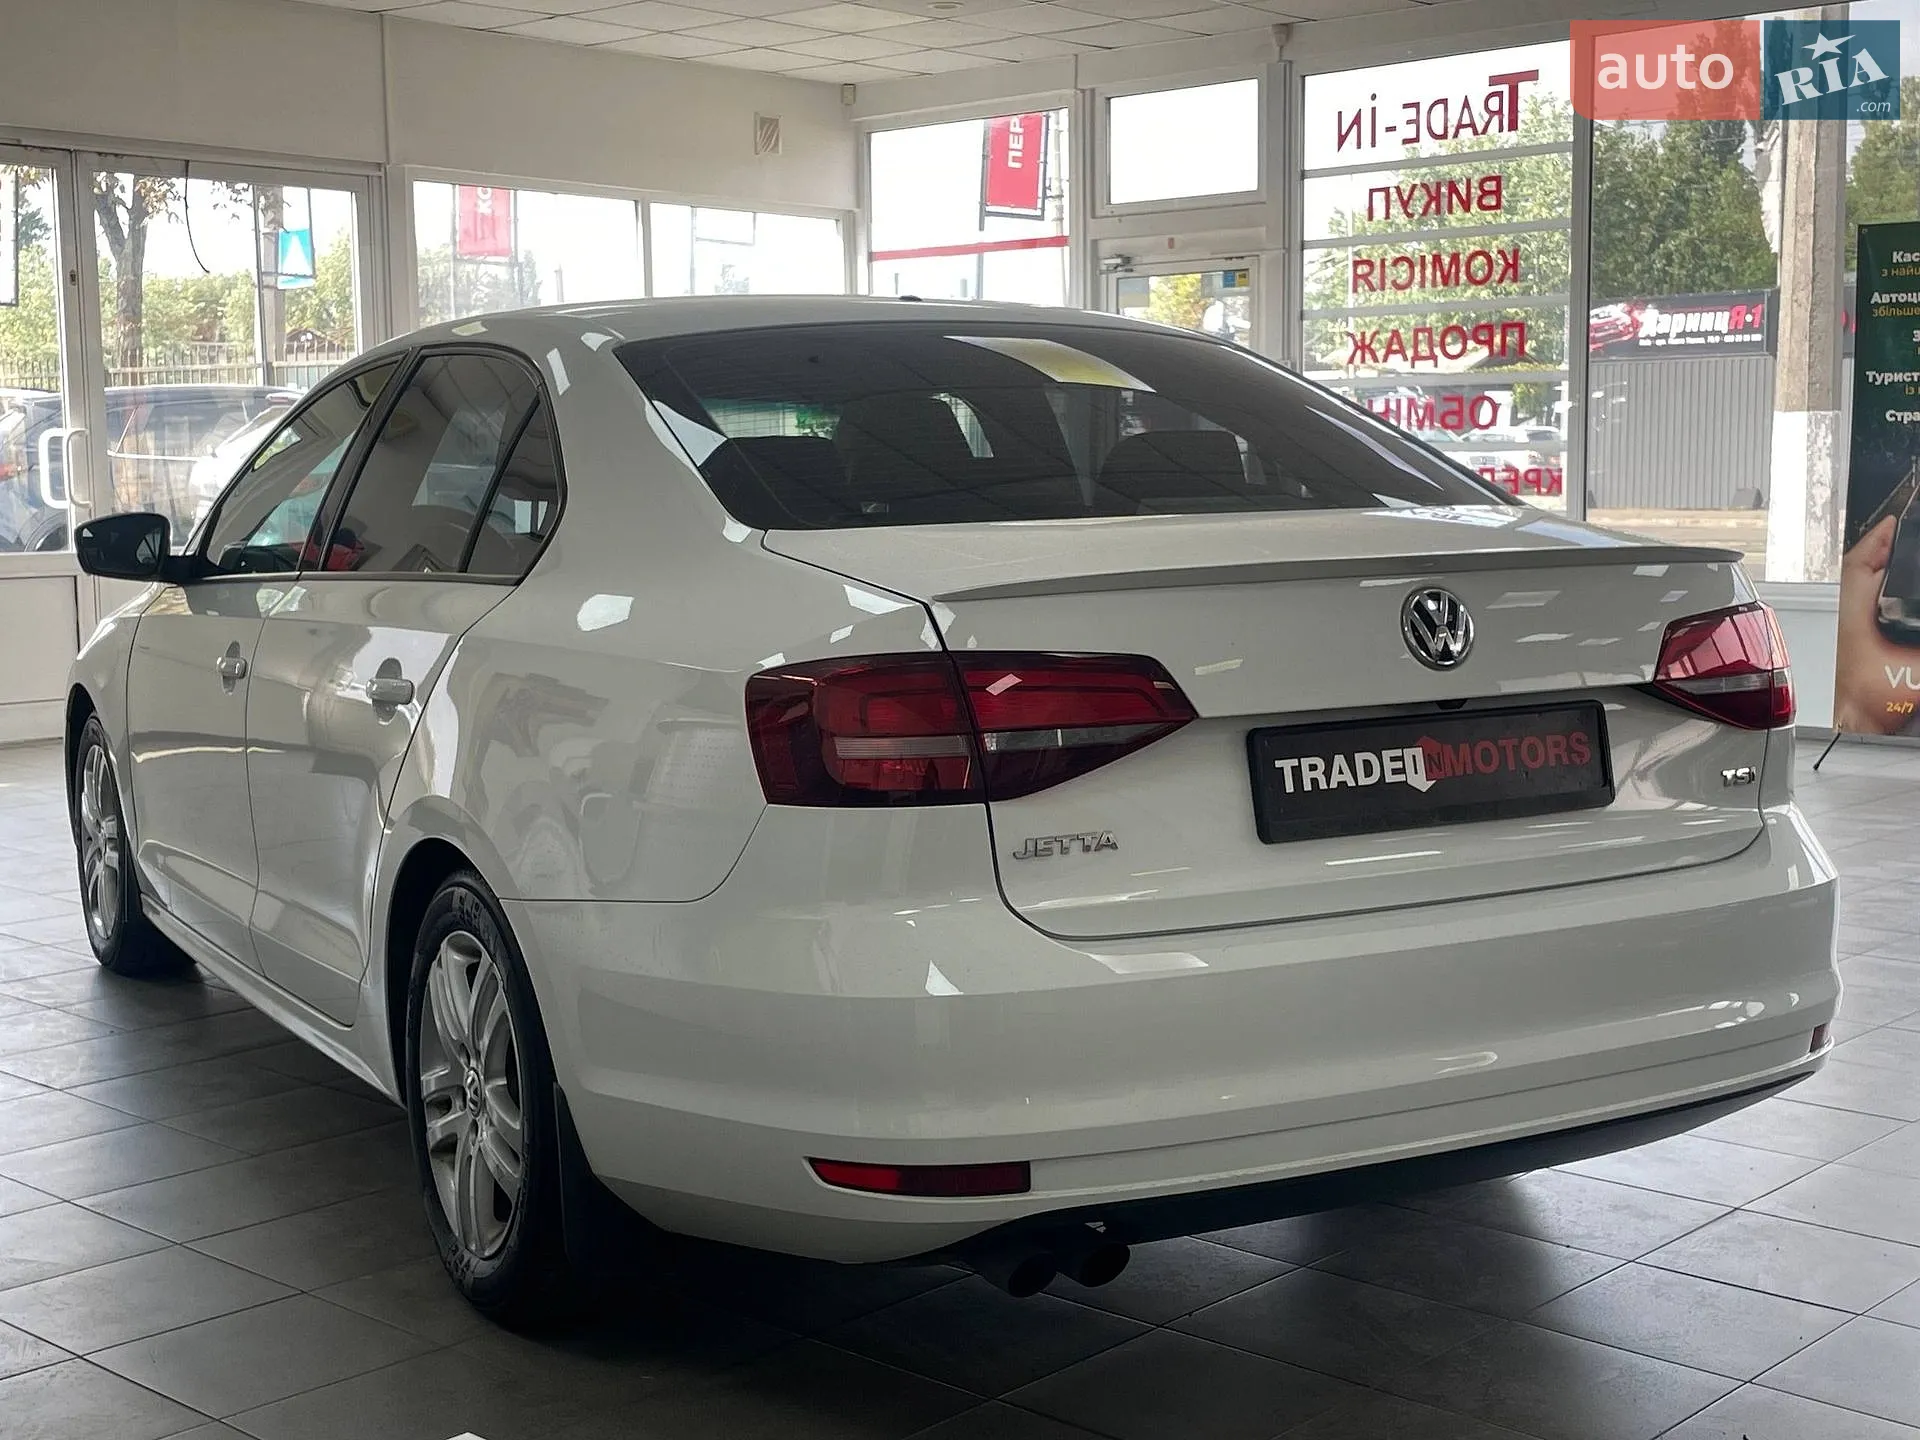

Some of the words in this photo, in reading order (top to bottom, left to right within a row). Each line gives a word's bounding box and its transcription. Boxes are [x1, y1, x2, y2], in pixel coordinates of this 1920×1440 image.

[1870, 292, 1920, 304] Автоц
[1886, 701, 1914, 714] 24/7
[1012, 830, 1119, 860] JETTA
